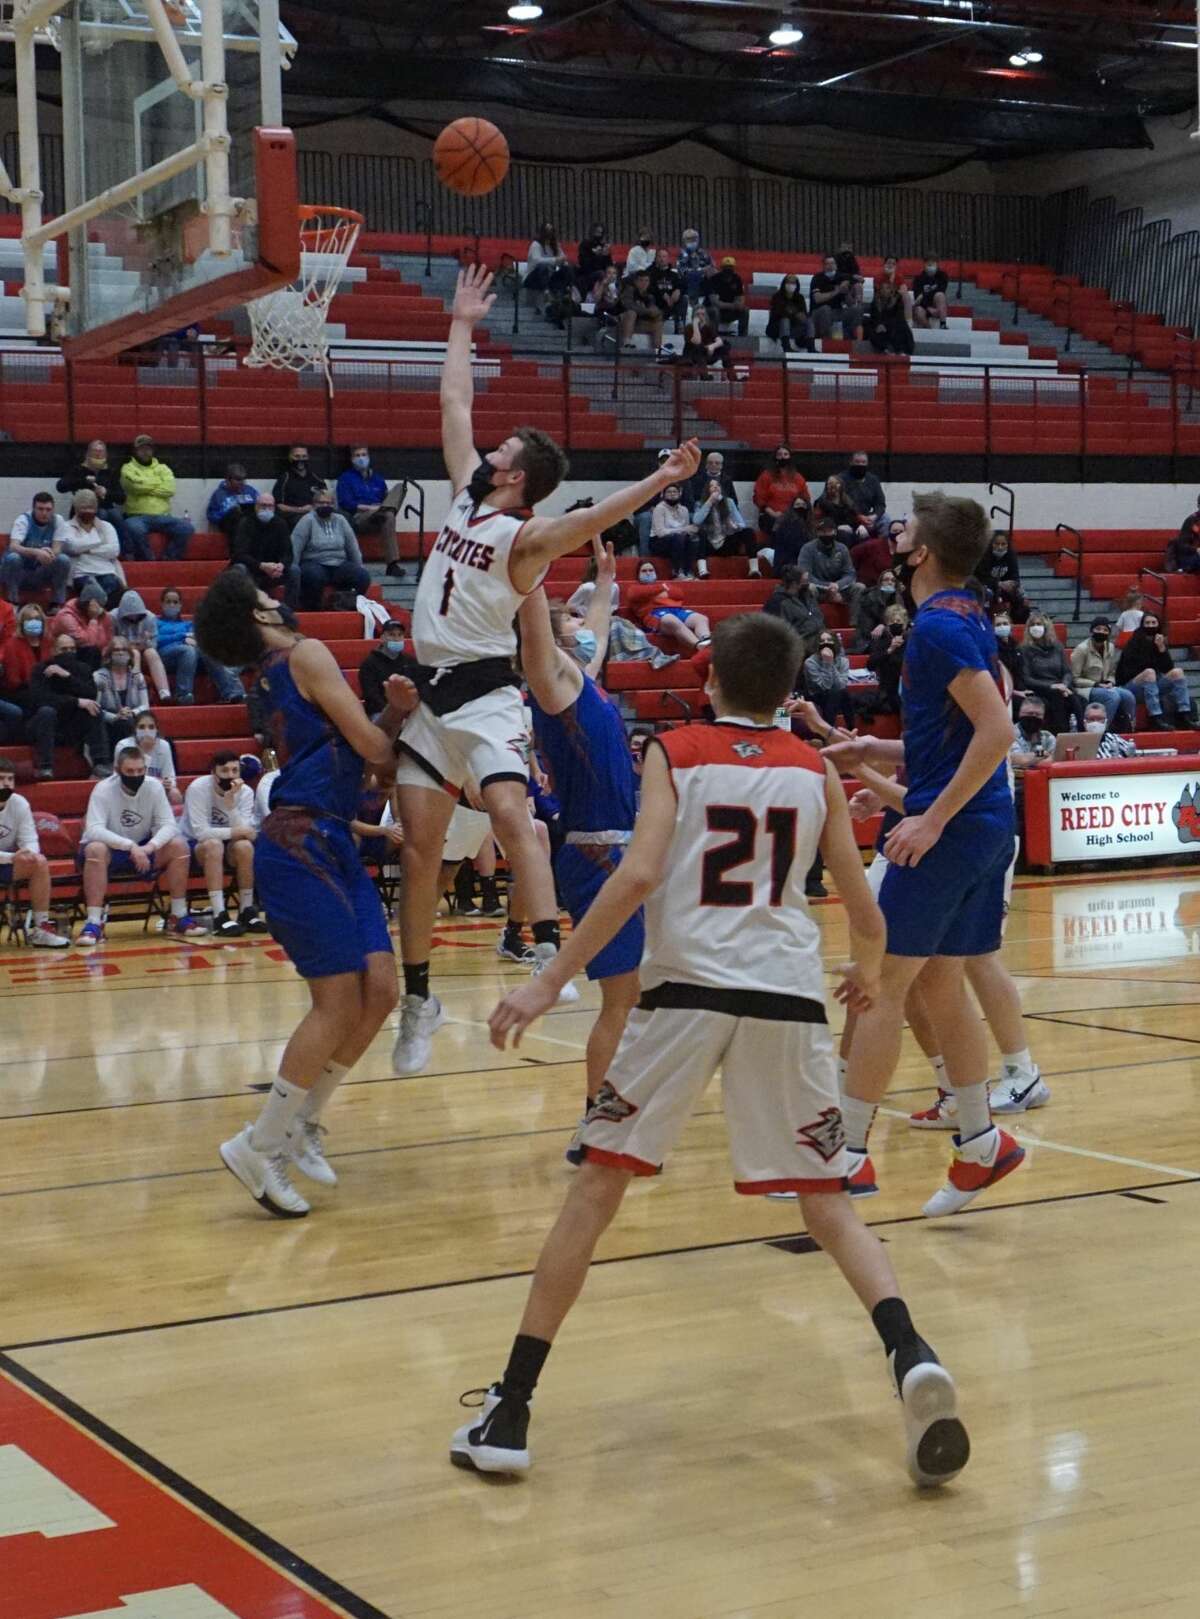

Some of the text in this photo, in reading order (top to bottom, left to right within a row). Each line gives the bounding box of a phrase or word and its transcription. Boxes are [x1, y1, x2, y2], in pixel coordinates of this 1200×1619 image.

[439, 567, 455, 617] 1
[1060, 791, 1120, 802] Welcome to
[1060, 802, 1167, 831] REED CITY
[1086, 831, 1154, 847] High School
[699, 804, 798, 908] 21
